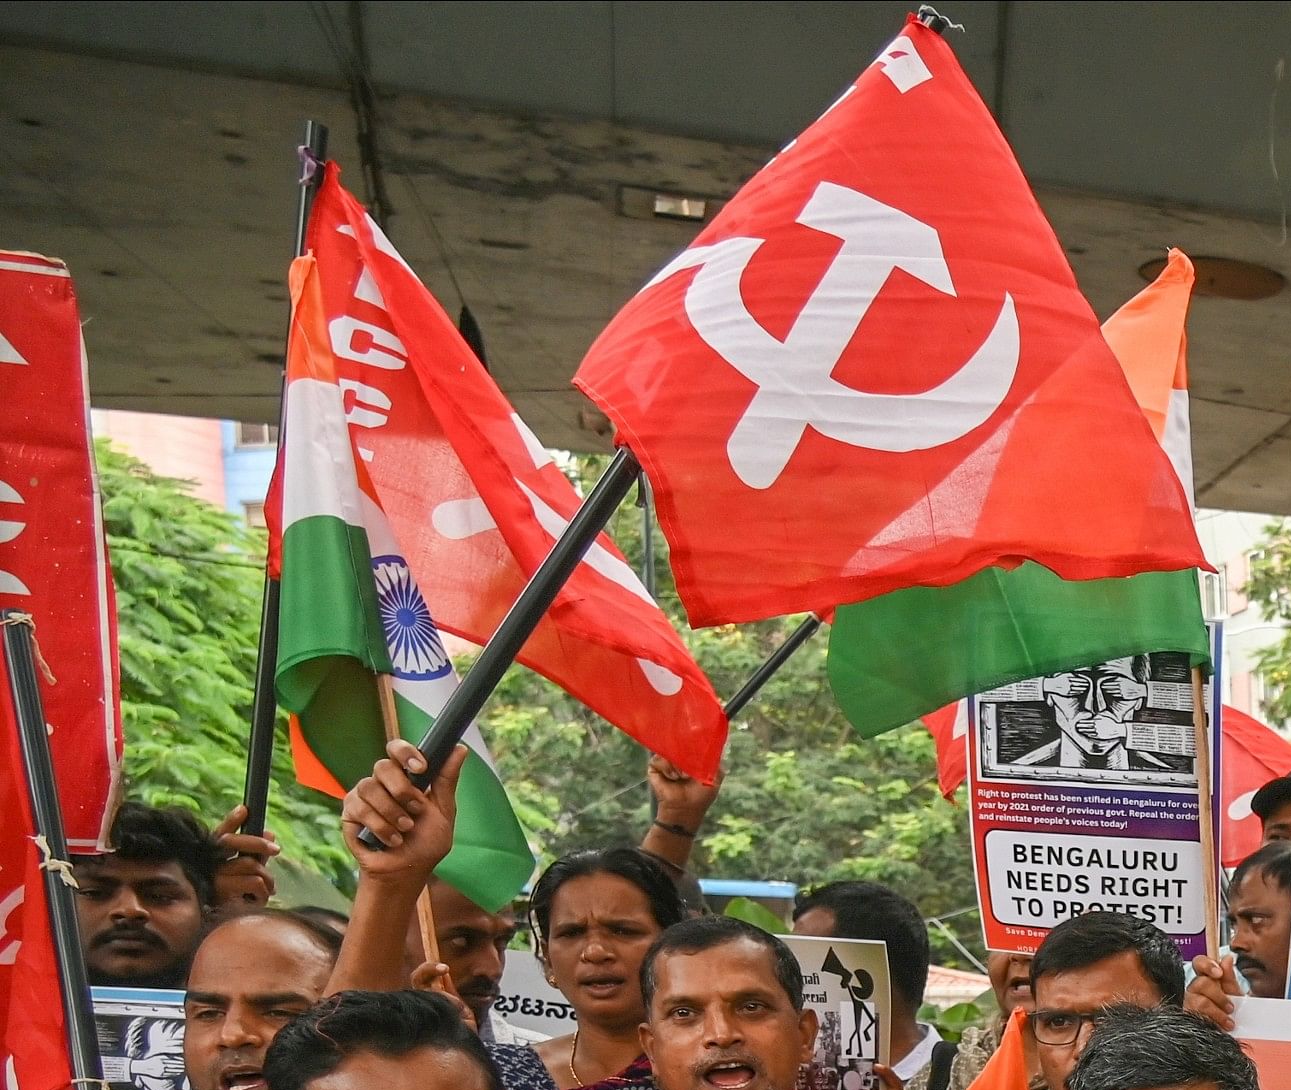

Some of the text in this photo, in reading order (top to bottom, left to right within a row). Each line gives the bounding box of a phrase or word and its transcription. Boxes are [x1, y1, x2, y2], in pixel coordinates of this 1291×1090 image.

[978, 812, 1127, 829] and reinstate people's voices today!
[1013, 843, 1178, 871] BENGALURU
[1007, 870, 1187, 898] NEEDS RIGHT
[1012, 896, 1043, 917] TO
[1005, 927, 1026, 937] Save
